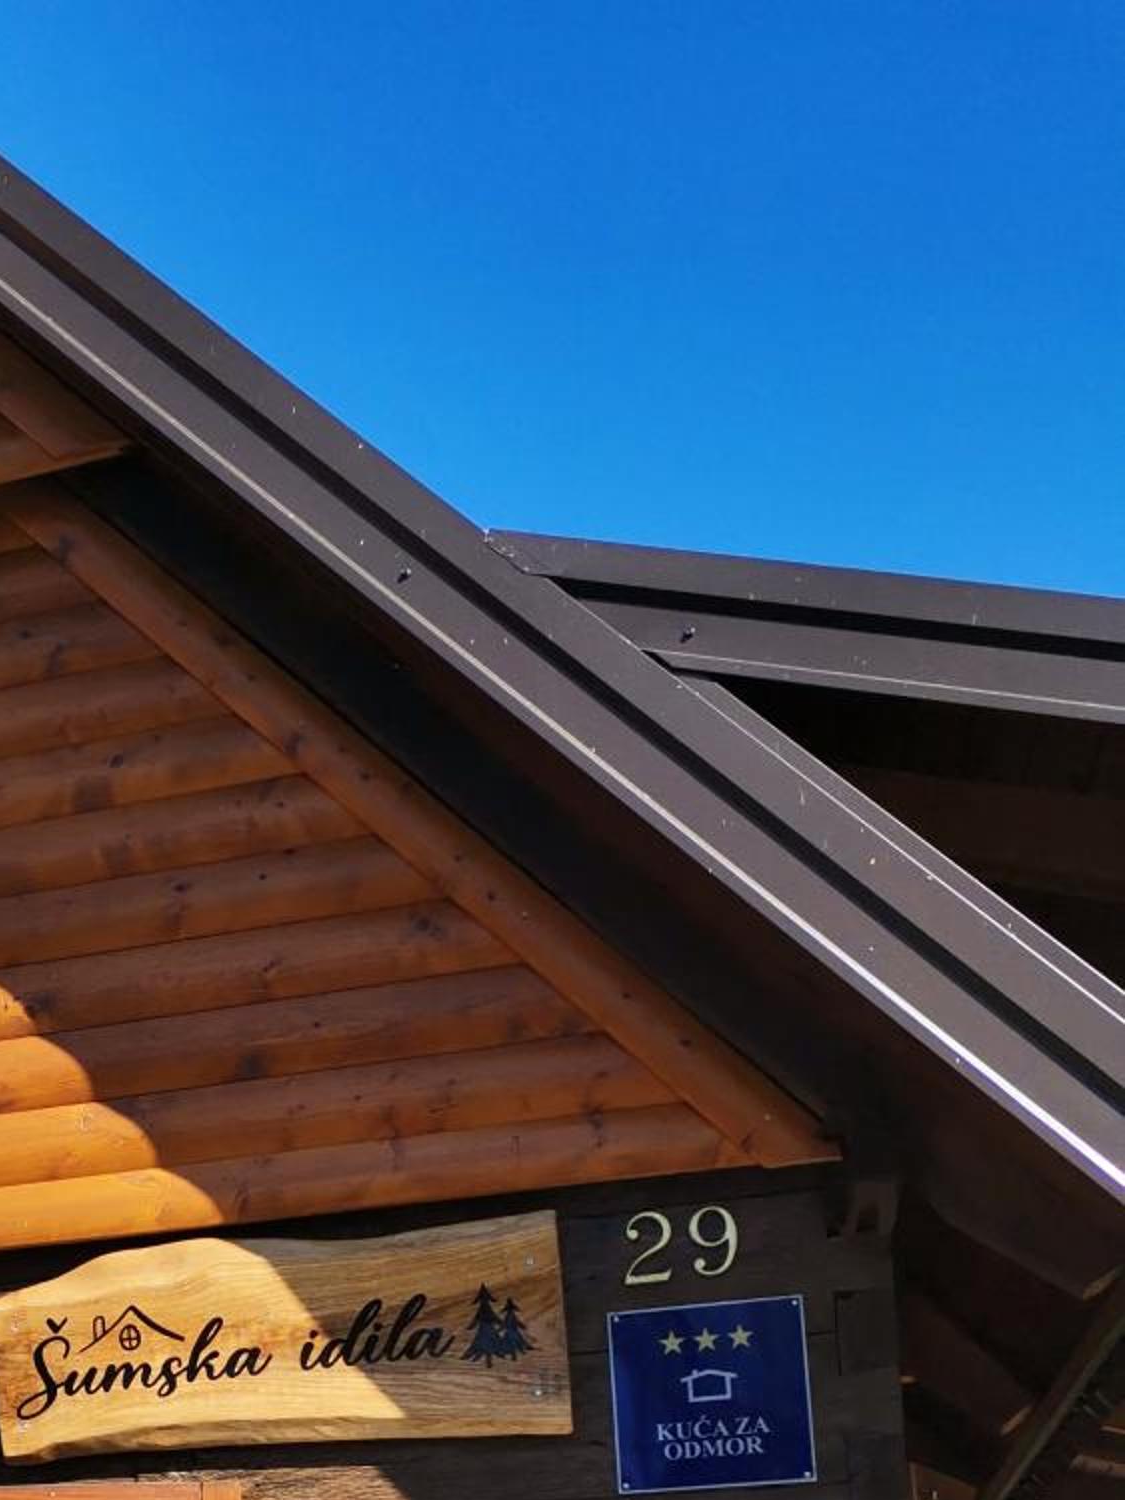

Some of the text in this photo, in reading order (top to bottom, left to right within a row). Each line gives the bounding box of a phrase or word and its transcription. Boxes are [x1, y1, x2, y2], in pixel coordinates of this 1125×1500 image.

[625, 1206, 738, 1285] 29
[16, 1293, 453, 1420] Šumska idila
[663, 1436, 764, 1460] ODMOR
[735, 1416, 771, 1435] ZA
